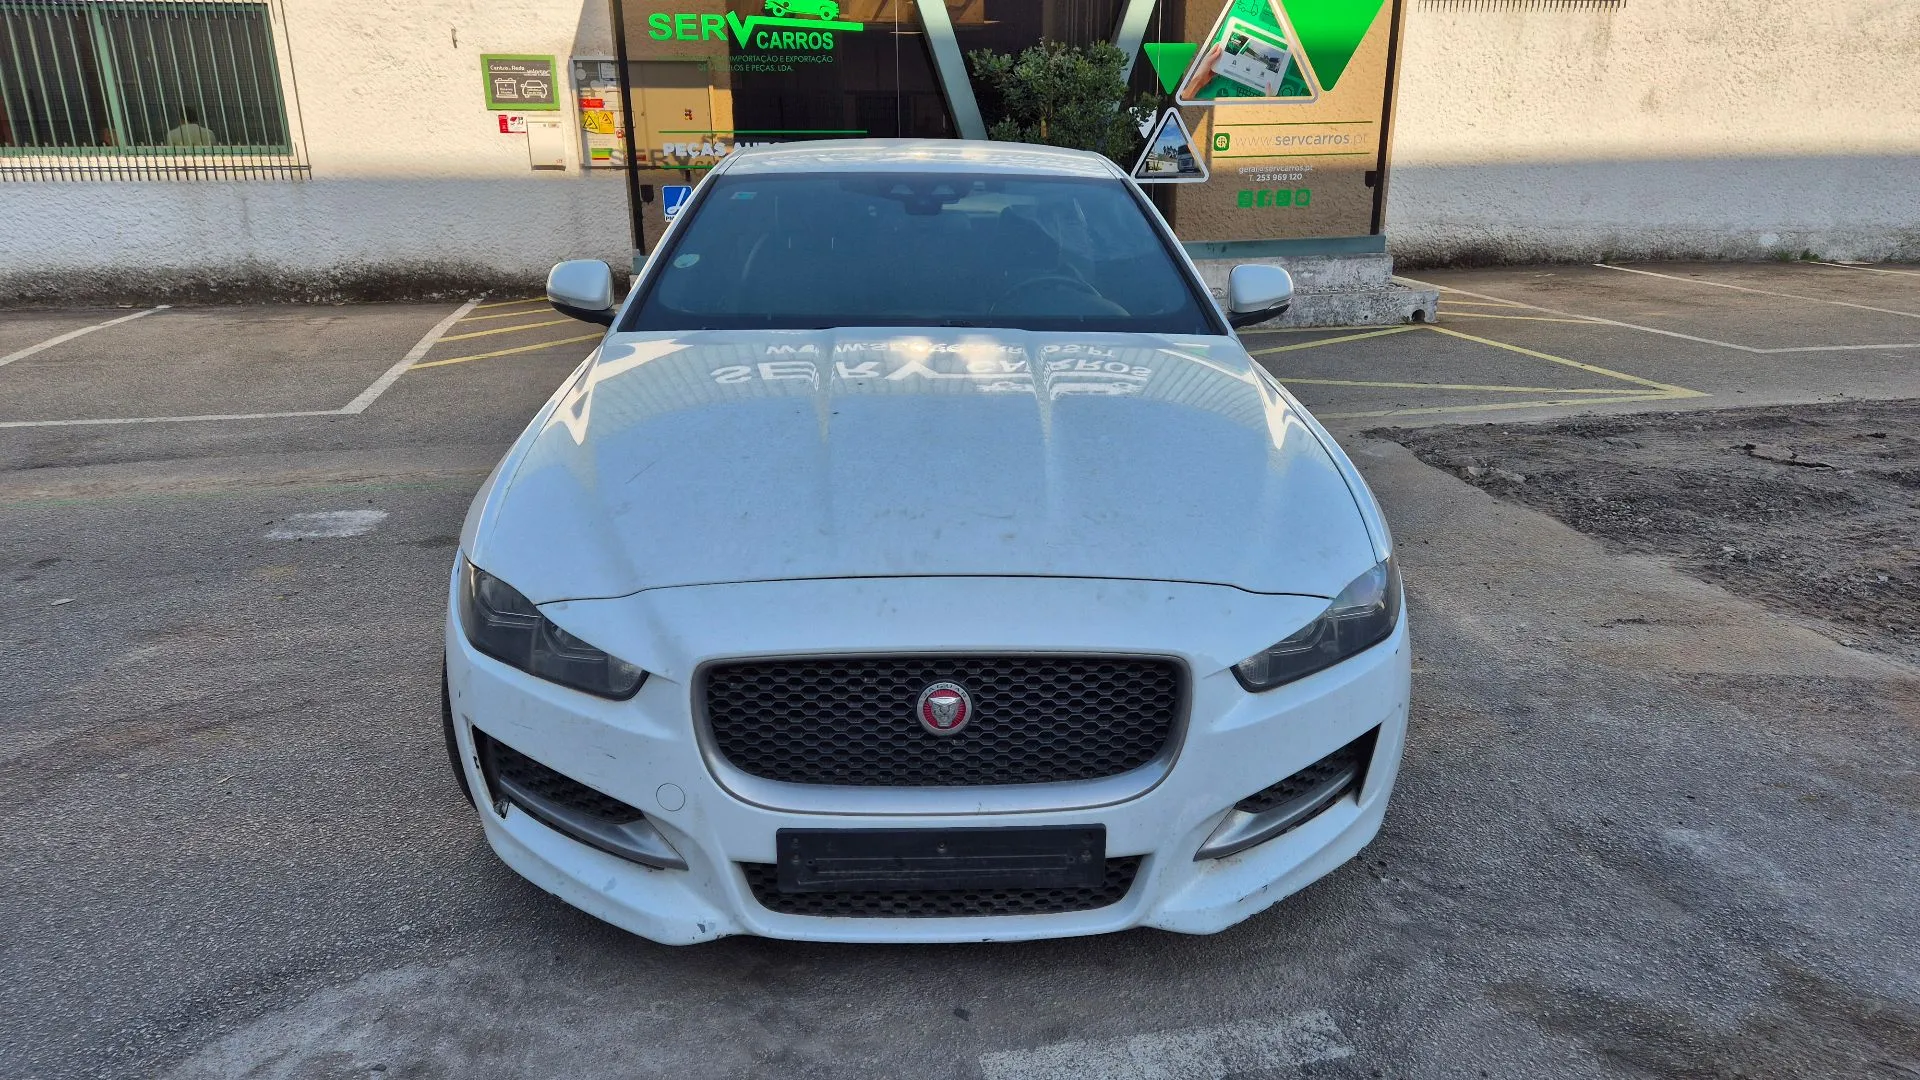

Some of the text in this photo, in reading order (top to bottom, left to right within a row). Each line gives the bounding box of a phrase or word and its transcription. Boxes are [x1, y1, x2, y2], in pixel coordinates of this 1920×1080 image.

[648, 10, 756, 50] SERV
[756, 31, 834, 50] CARROS
[786, 54, 833, 64] EXPORTAÇÃO
[662, 142, 726, 158] PEÇAS
[1256, 173, 1271, 182] 253
[1273, 173, 1288, 181] 969
[1289, 173, 1303, 181] 120
